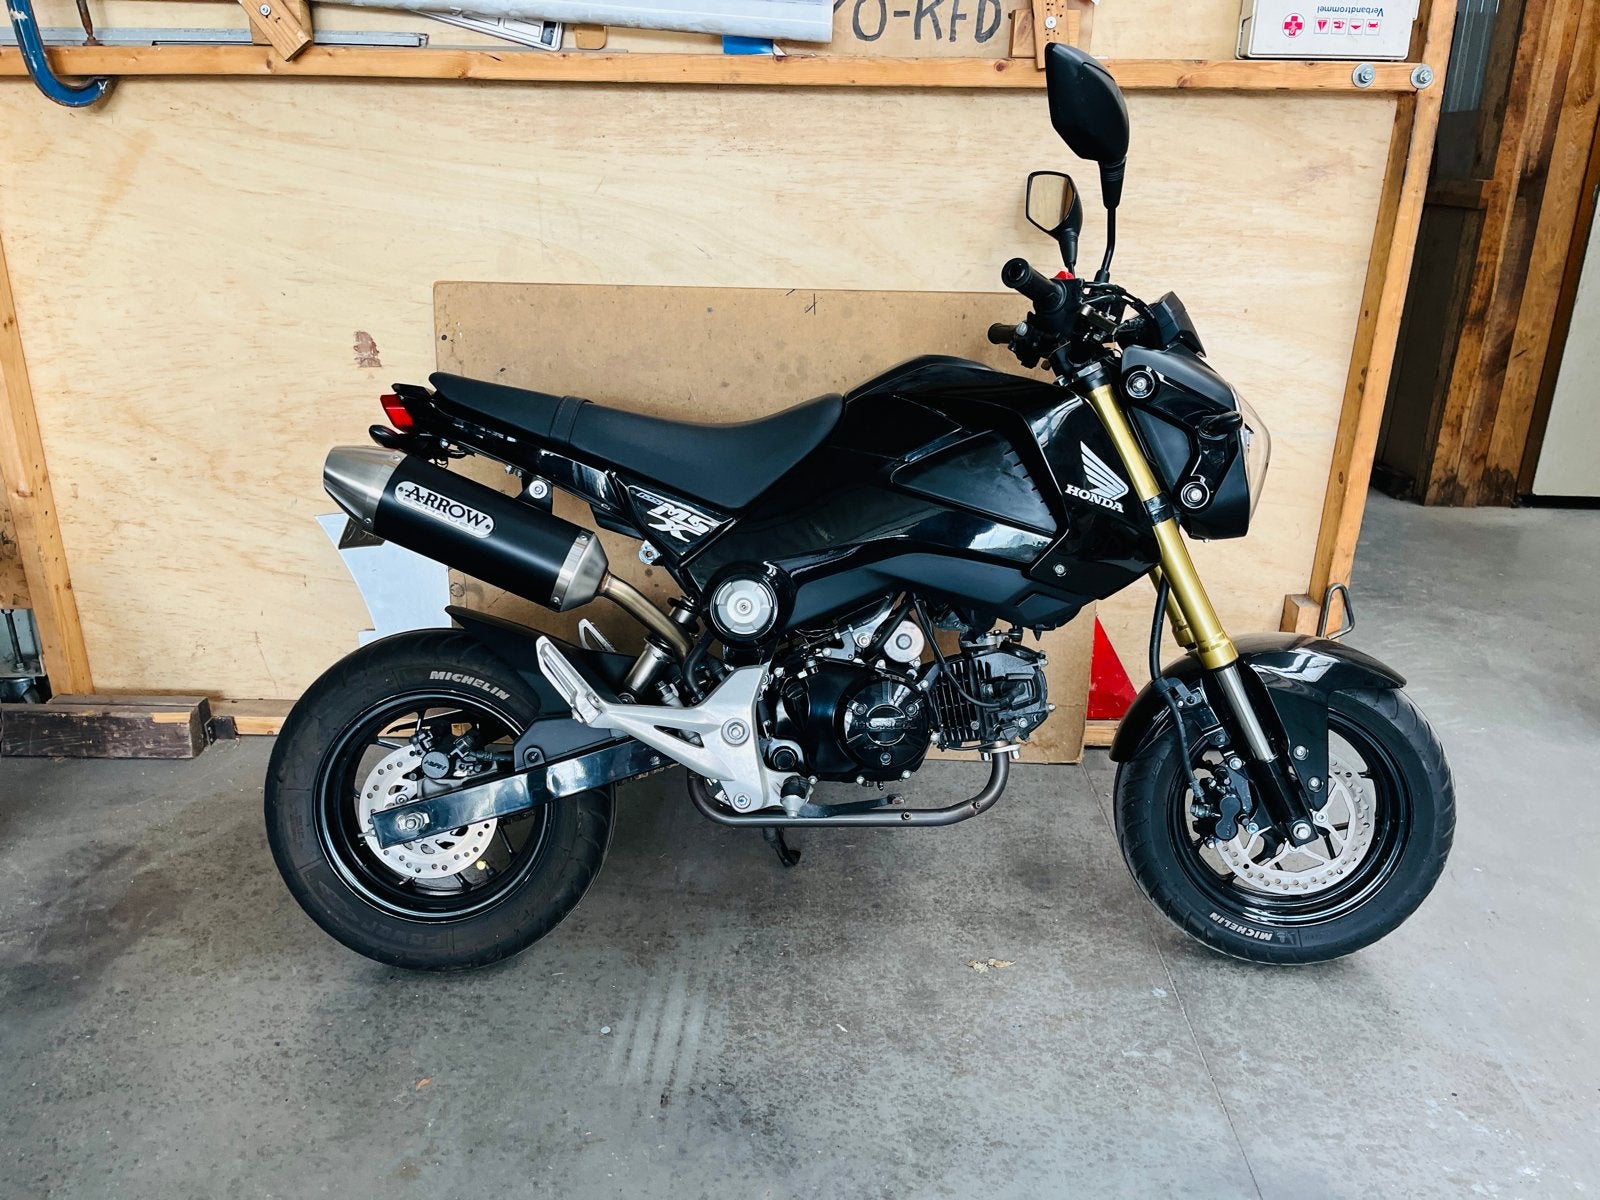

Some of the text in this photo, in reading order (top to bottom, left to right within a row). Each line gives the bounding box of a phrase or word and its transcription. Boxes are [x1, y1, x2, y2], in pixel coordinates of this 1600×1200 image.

[1317, 6, 1384, 17] Verbandtrommel
[404, 485, 488, 527] ARROW
[1065, 484, 1124, 513] HONDA
[429, 670, 511, 700] MICHELIN
[1209, 911, 1273, 941] MICHELIN
